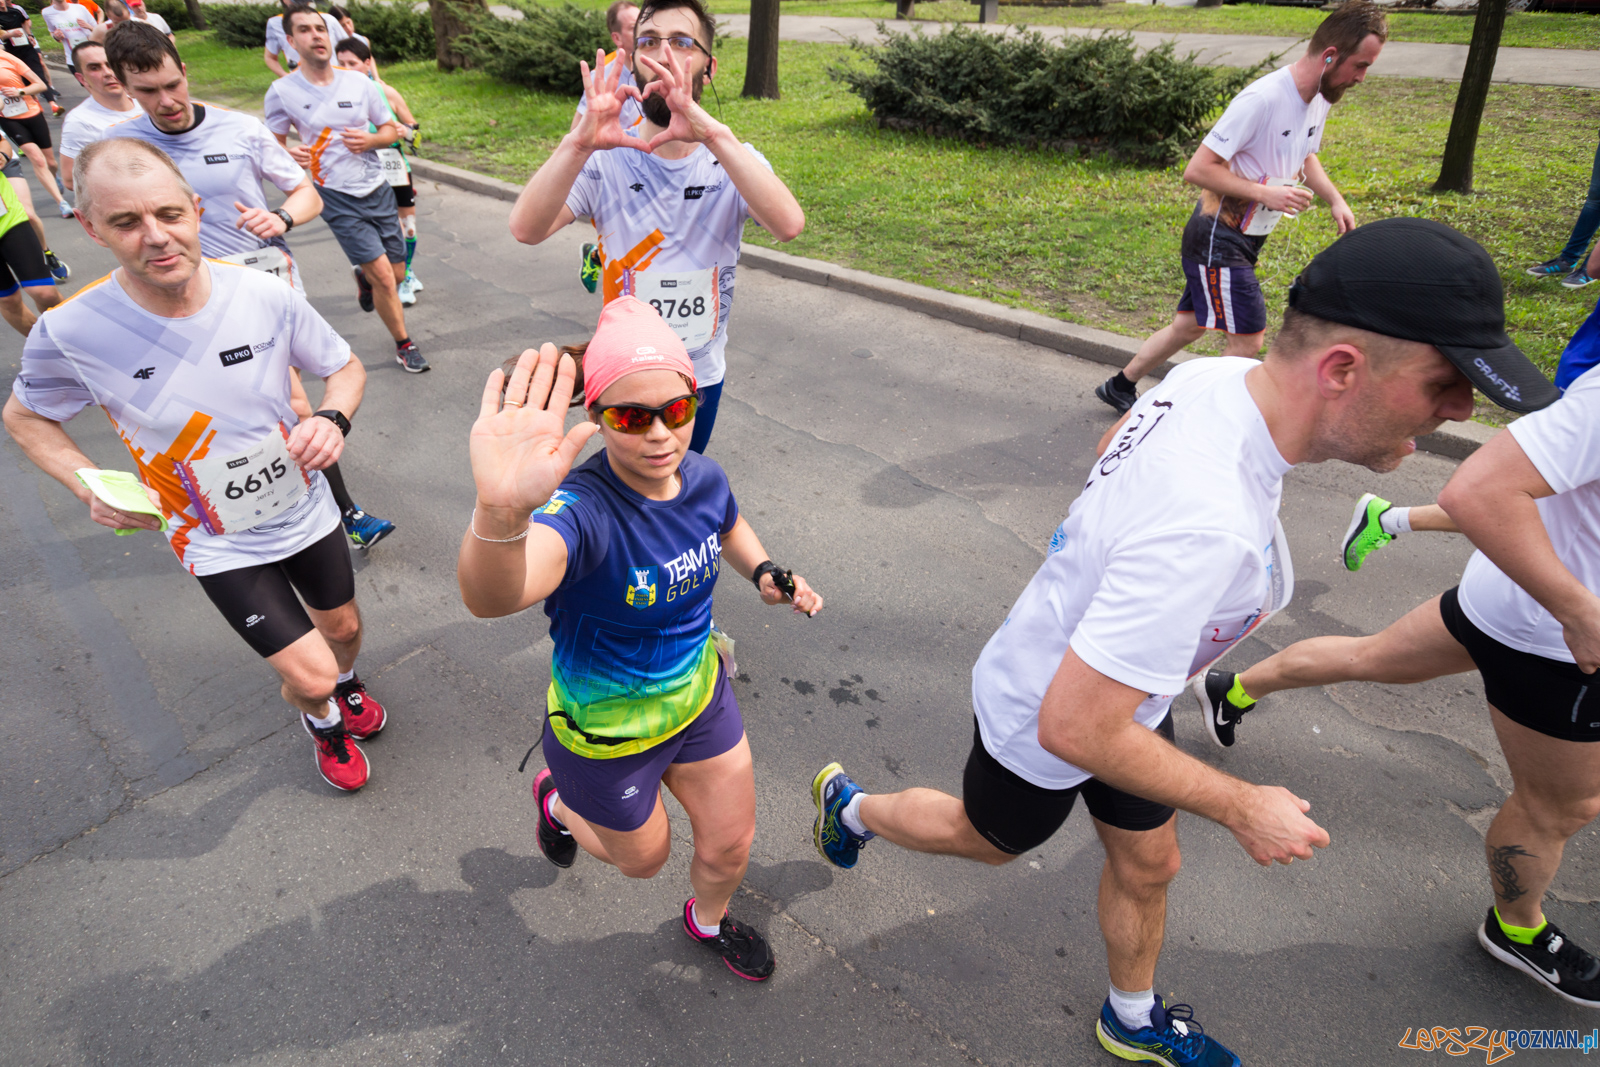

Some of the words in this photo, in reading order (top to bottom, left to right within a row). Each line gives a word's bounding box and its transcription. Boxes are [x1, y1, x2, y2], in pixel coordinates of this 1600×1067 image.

[1473, 357, 1512, 392] CRAFT
[225, 457, 287, 500] 6615
[255, 489, 275, 501] Jerzy
[663, 541, 708, 585] TEAM
